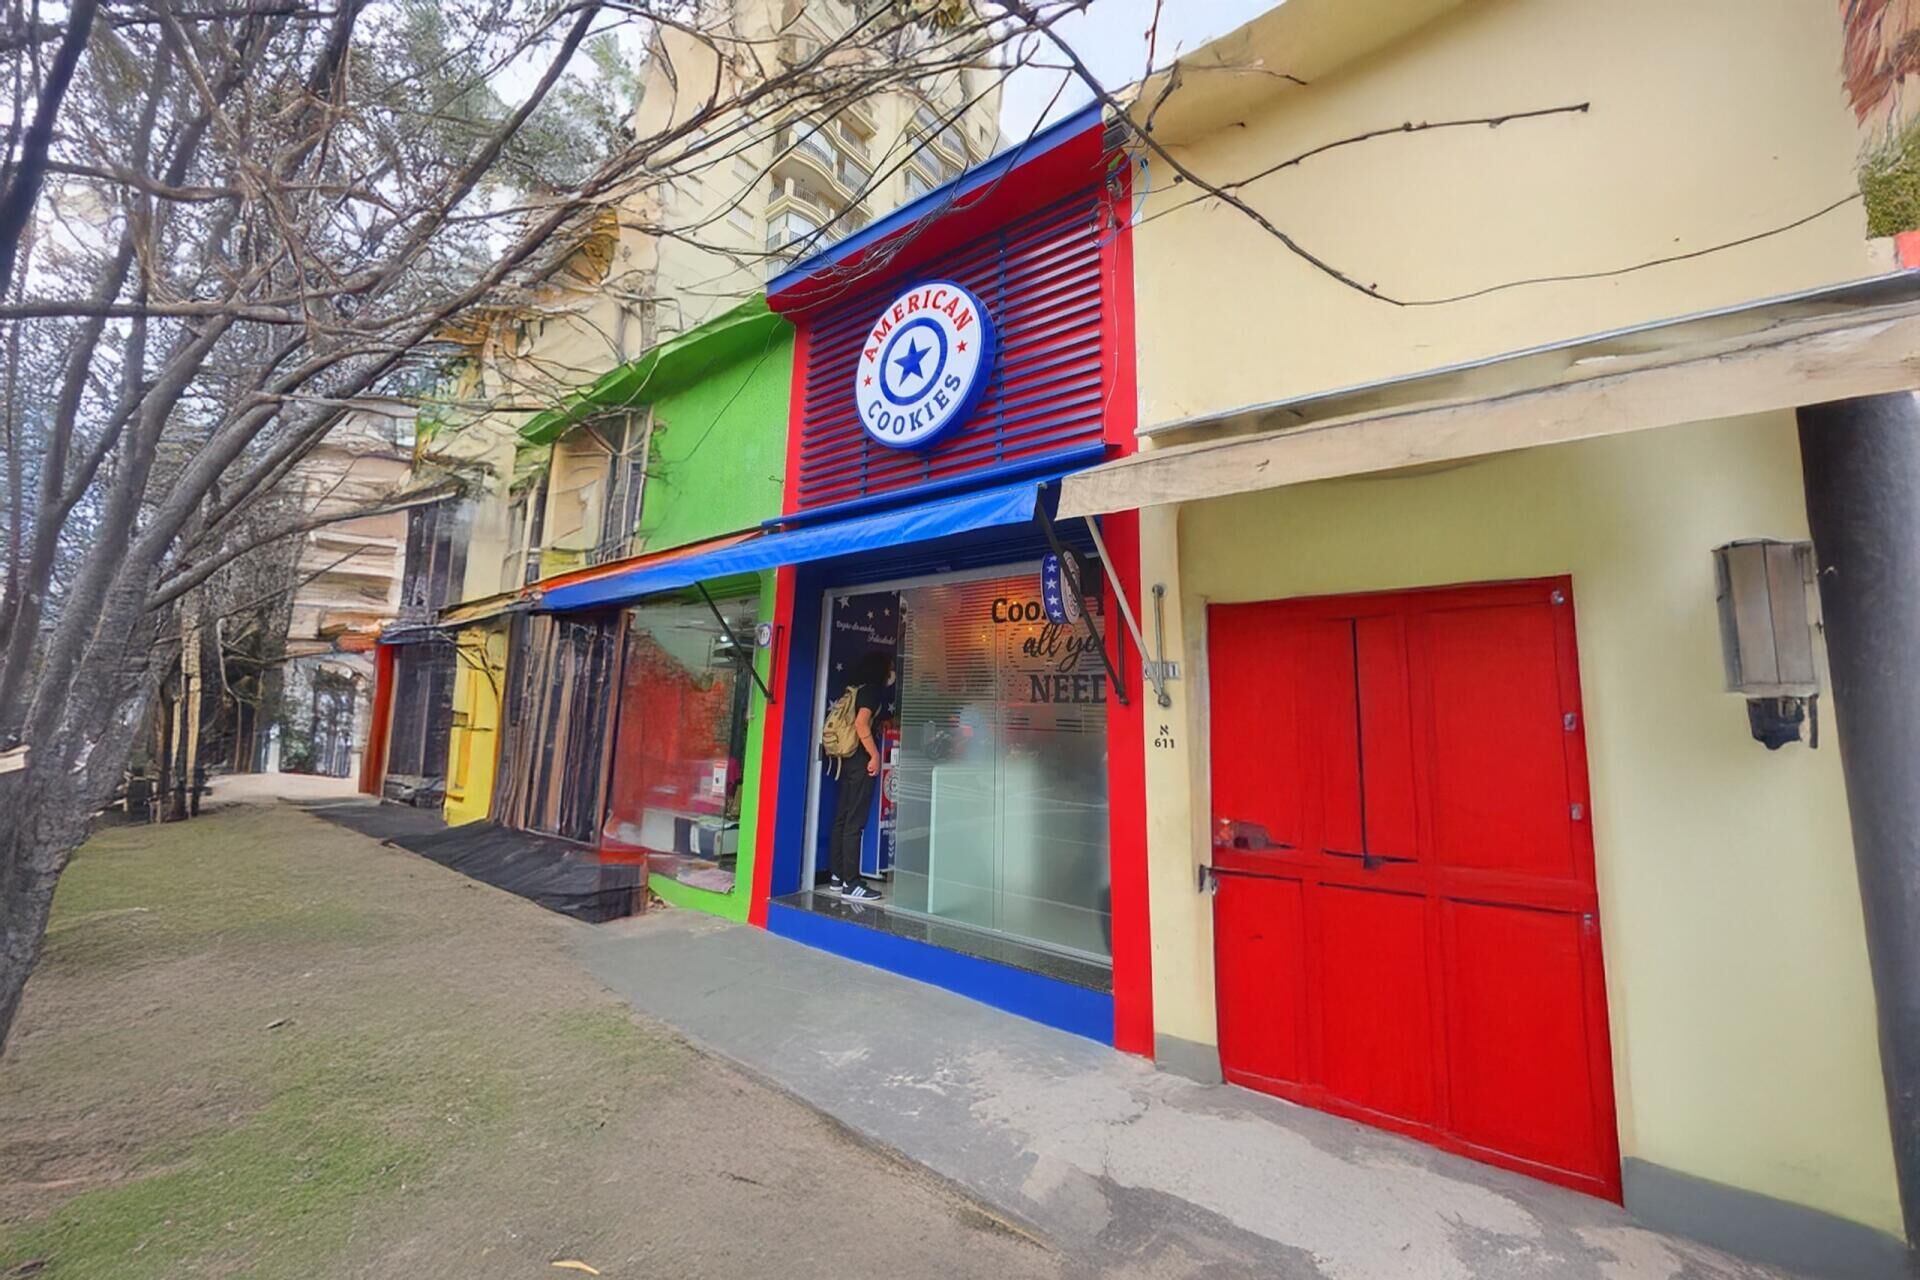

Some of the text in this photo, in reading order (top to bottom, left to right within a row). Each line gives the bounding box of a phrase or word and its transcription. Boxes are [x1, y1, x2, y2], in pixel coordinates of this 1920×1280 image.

[864, 289, 973, 363] AMERICAN
[868, 373, 961, 436] COOKIES
[1023, 623, 1063, 657] all
[1154, 737, 1175, 749] 611
